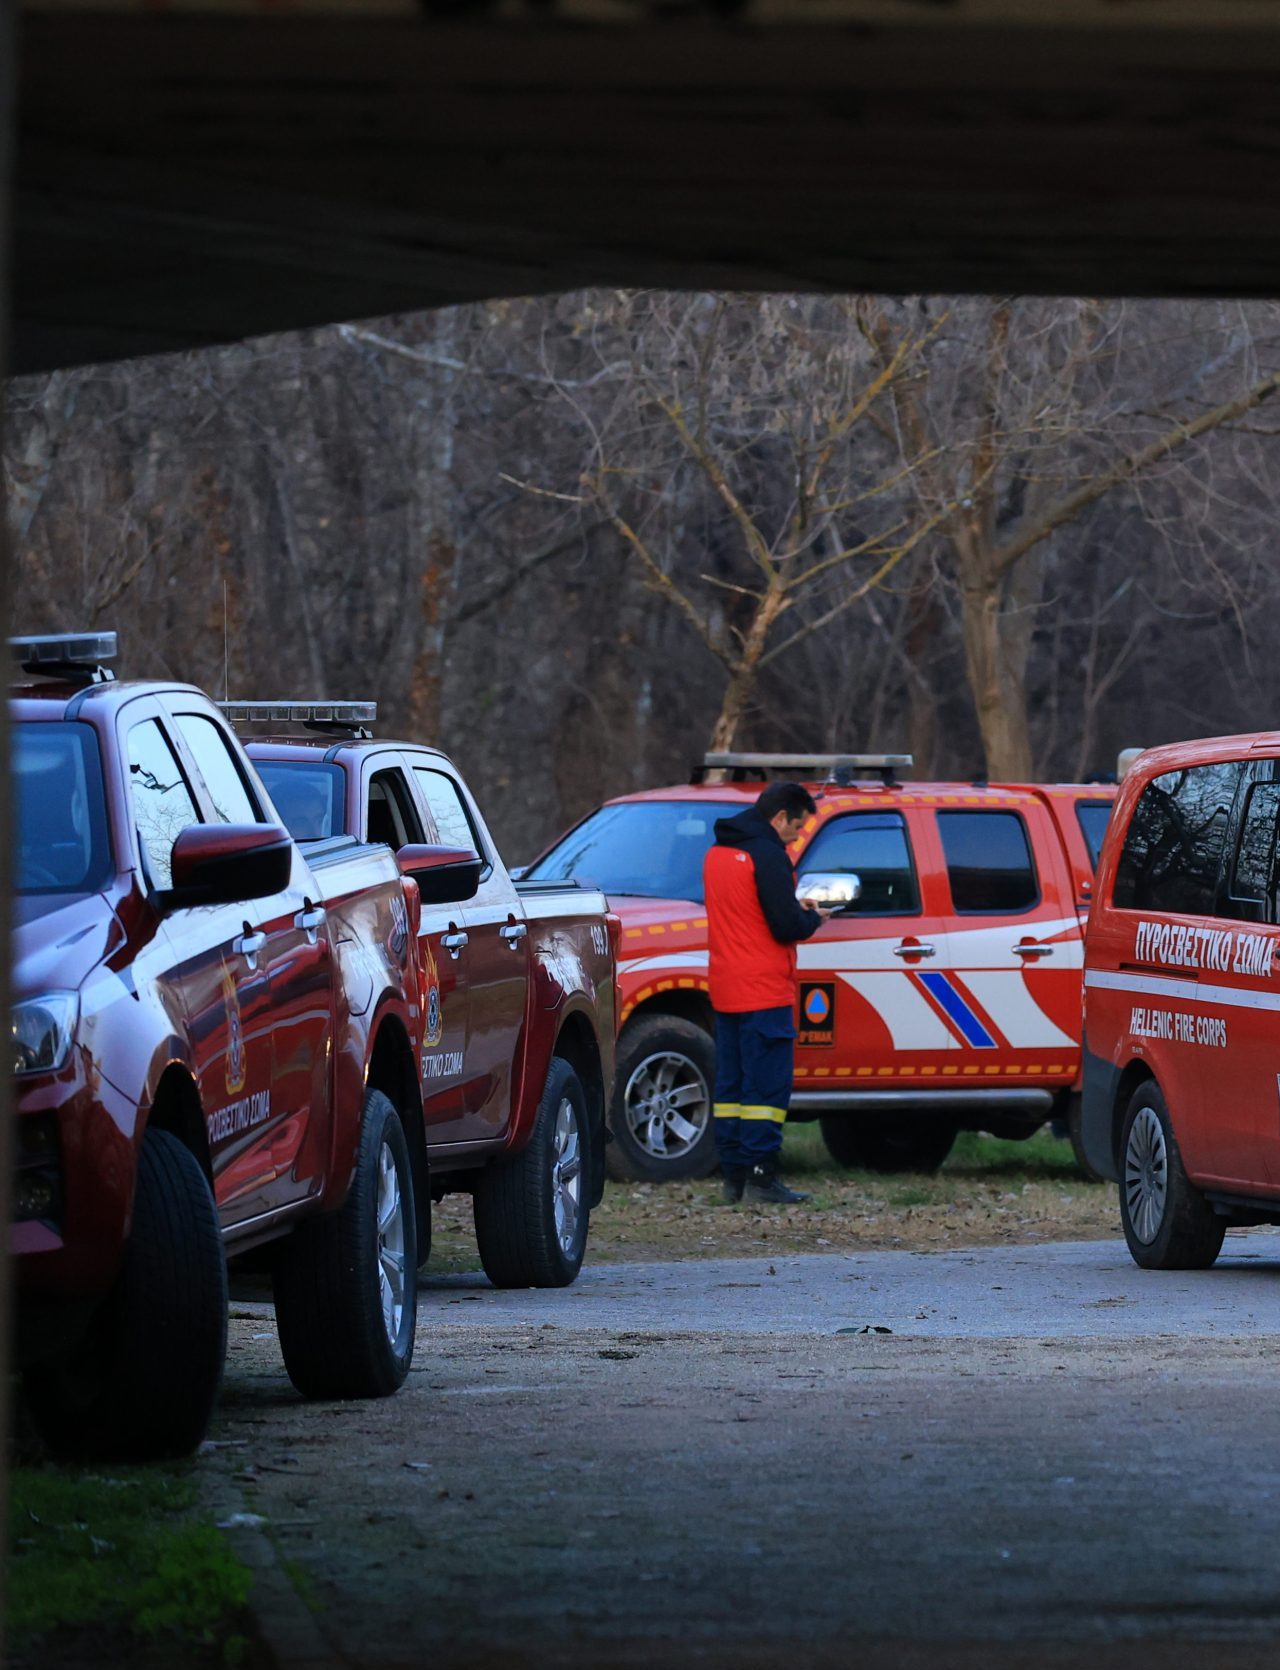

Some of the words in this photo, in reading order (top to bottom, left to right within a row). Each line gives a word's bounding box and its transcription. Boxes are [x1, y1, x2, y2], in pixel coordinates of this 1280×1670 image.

[1135, 921, 1233, 972] ΠΥΡΟΣΒΕΣΤΙΚΟ
[1232, 933, 1275, 977] ΣΩΜΑ
[1129, 1007, 1173, 1040] HELLENIC
[1174, 1012, 1196, 1043] FIRE
[1196, 1016, 1227, 1048] CORPS
[443, 1052, 463, 1076] ΣΩΜΑ
